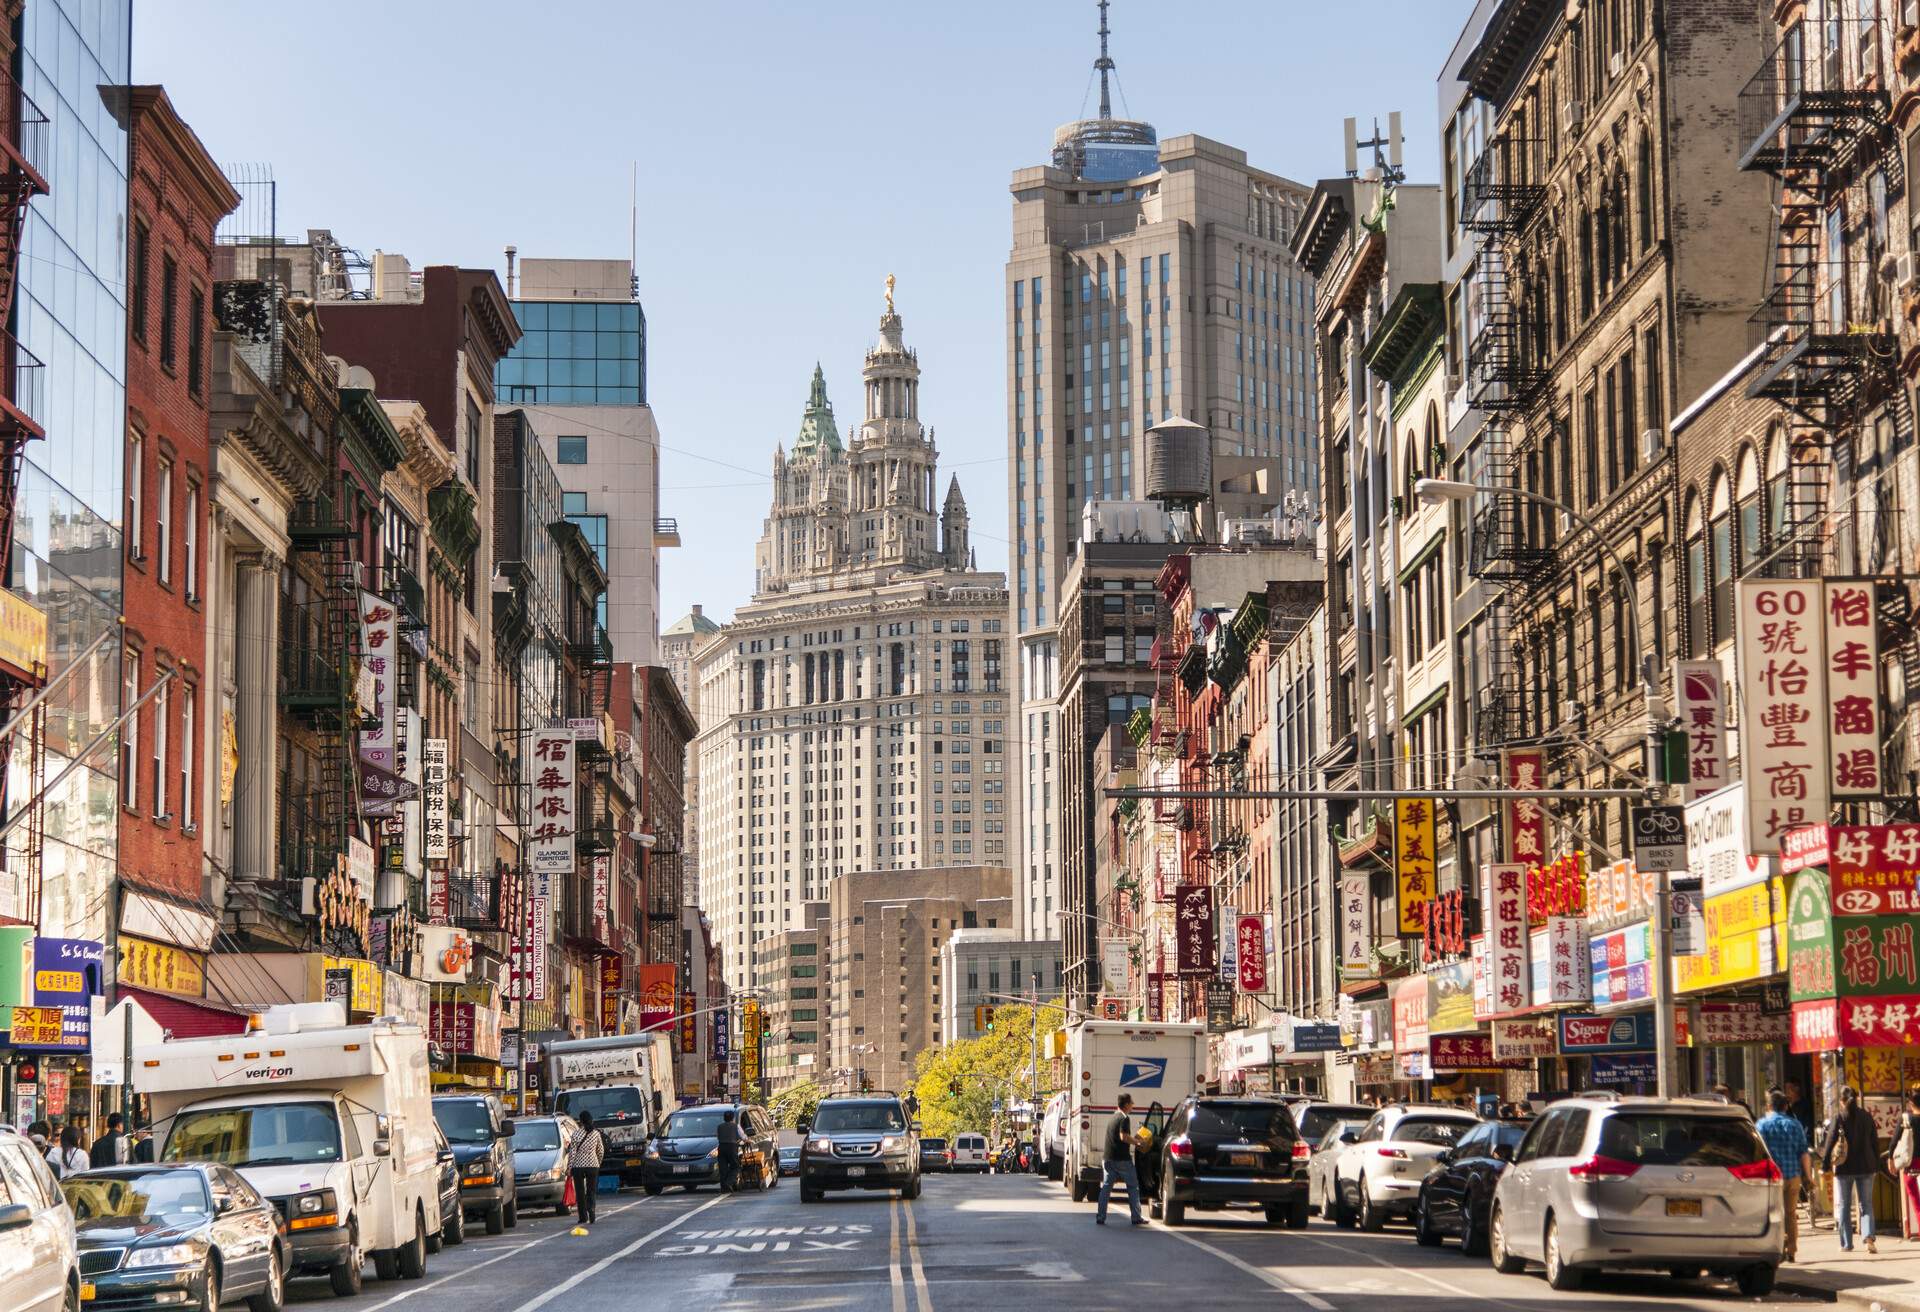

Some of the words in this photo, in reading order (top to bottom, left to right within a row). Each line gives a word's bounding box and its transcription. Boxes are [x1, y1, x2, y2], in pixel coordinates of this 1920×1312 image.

[1690, 706, 1719, 780] 東方紅
[1515, 762, 1542, 869] 農家飯
[1637, 835, 1658, 845] BIKE
[1660, 834, 1683, 843] LANE
[1833, 828, 1920, 867] 好好
[1402, 801, 1431, 928] 華美商場
[1648, 849, 1674, 858] BIKES
[1650, 859, 1673, 868] ONLY
[1842, 892, 1873, 910] 62
[1888, 890, 1909, 909] TEL
[535, 900, 543, 922] PARIS
[535, 924, 543, 962] WEDDING
[1498, 871, 1525, 1008] 興旺旺商場
[1841, 922, 1917, 987] 福州
[535, 964, 543, 998] CENTER
[14, 1008, 61, 1025] 永順
[640, 1003, 674, 1014] Library
[1848, 1003, 1920, 1035] 好好
[246, 1066, 293, 1079] verizon
[676, 1224, 873, 1240] SCHOOL
